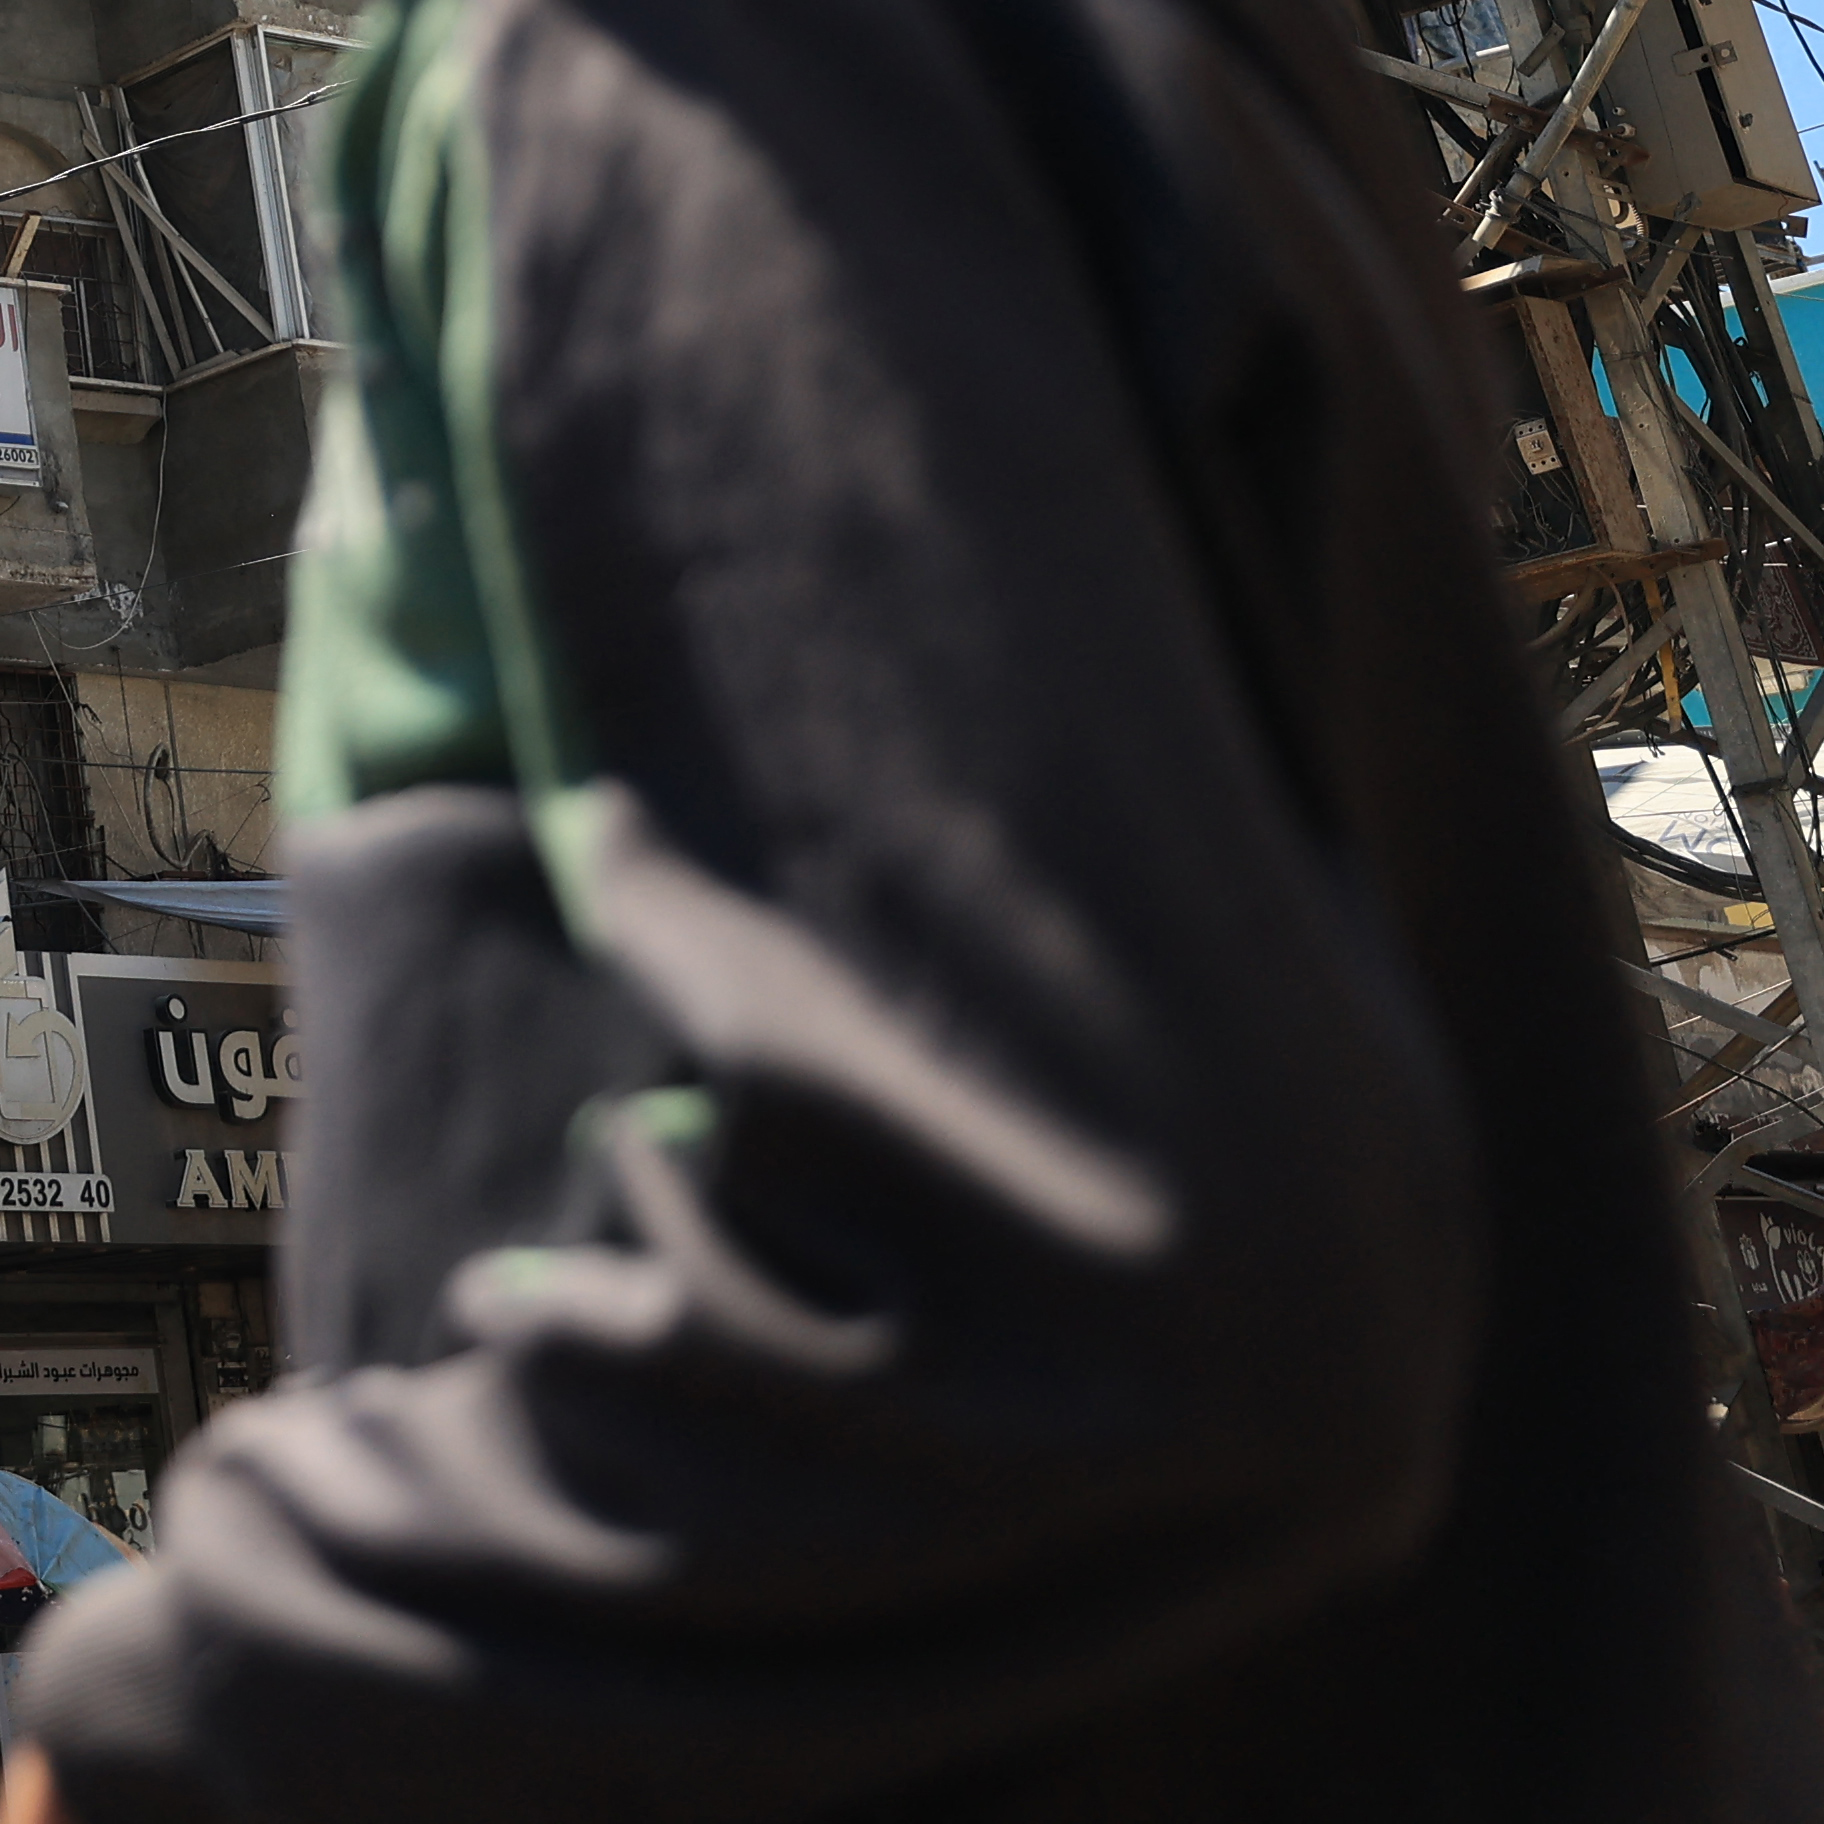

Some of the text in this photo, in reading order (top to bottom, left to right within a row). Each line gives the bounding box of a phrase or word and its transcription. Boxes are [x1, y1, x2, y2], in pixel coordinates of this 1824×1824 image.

[79, 1178, 112, 1209] 40
[43, 1365, 77, 1383] عبود
[79, 1362, 140, 1382] مجوهرات
